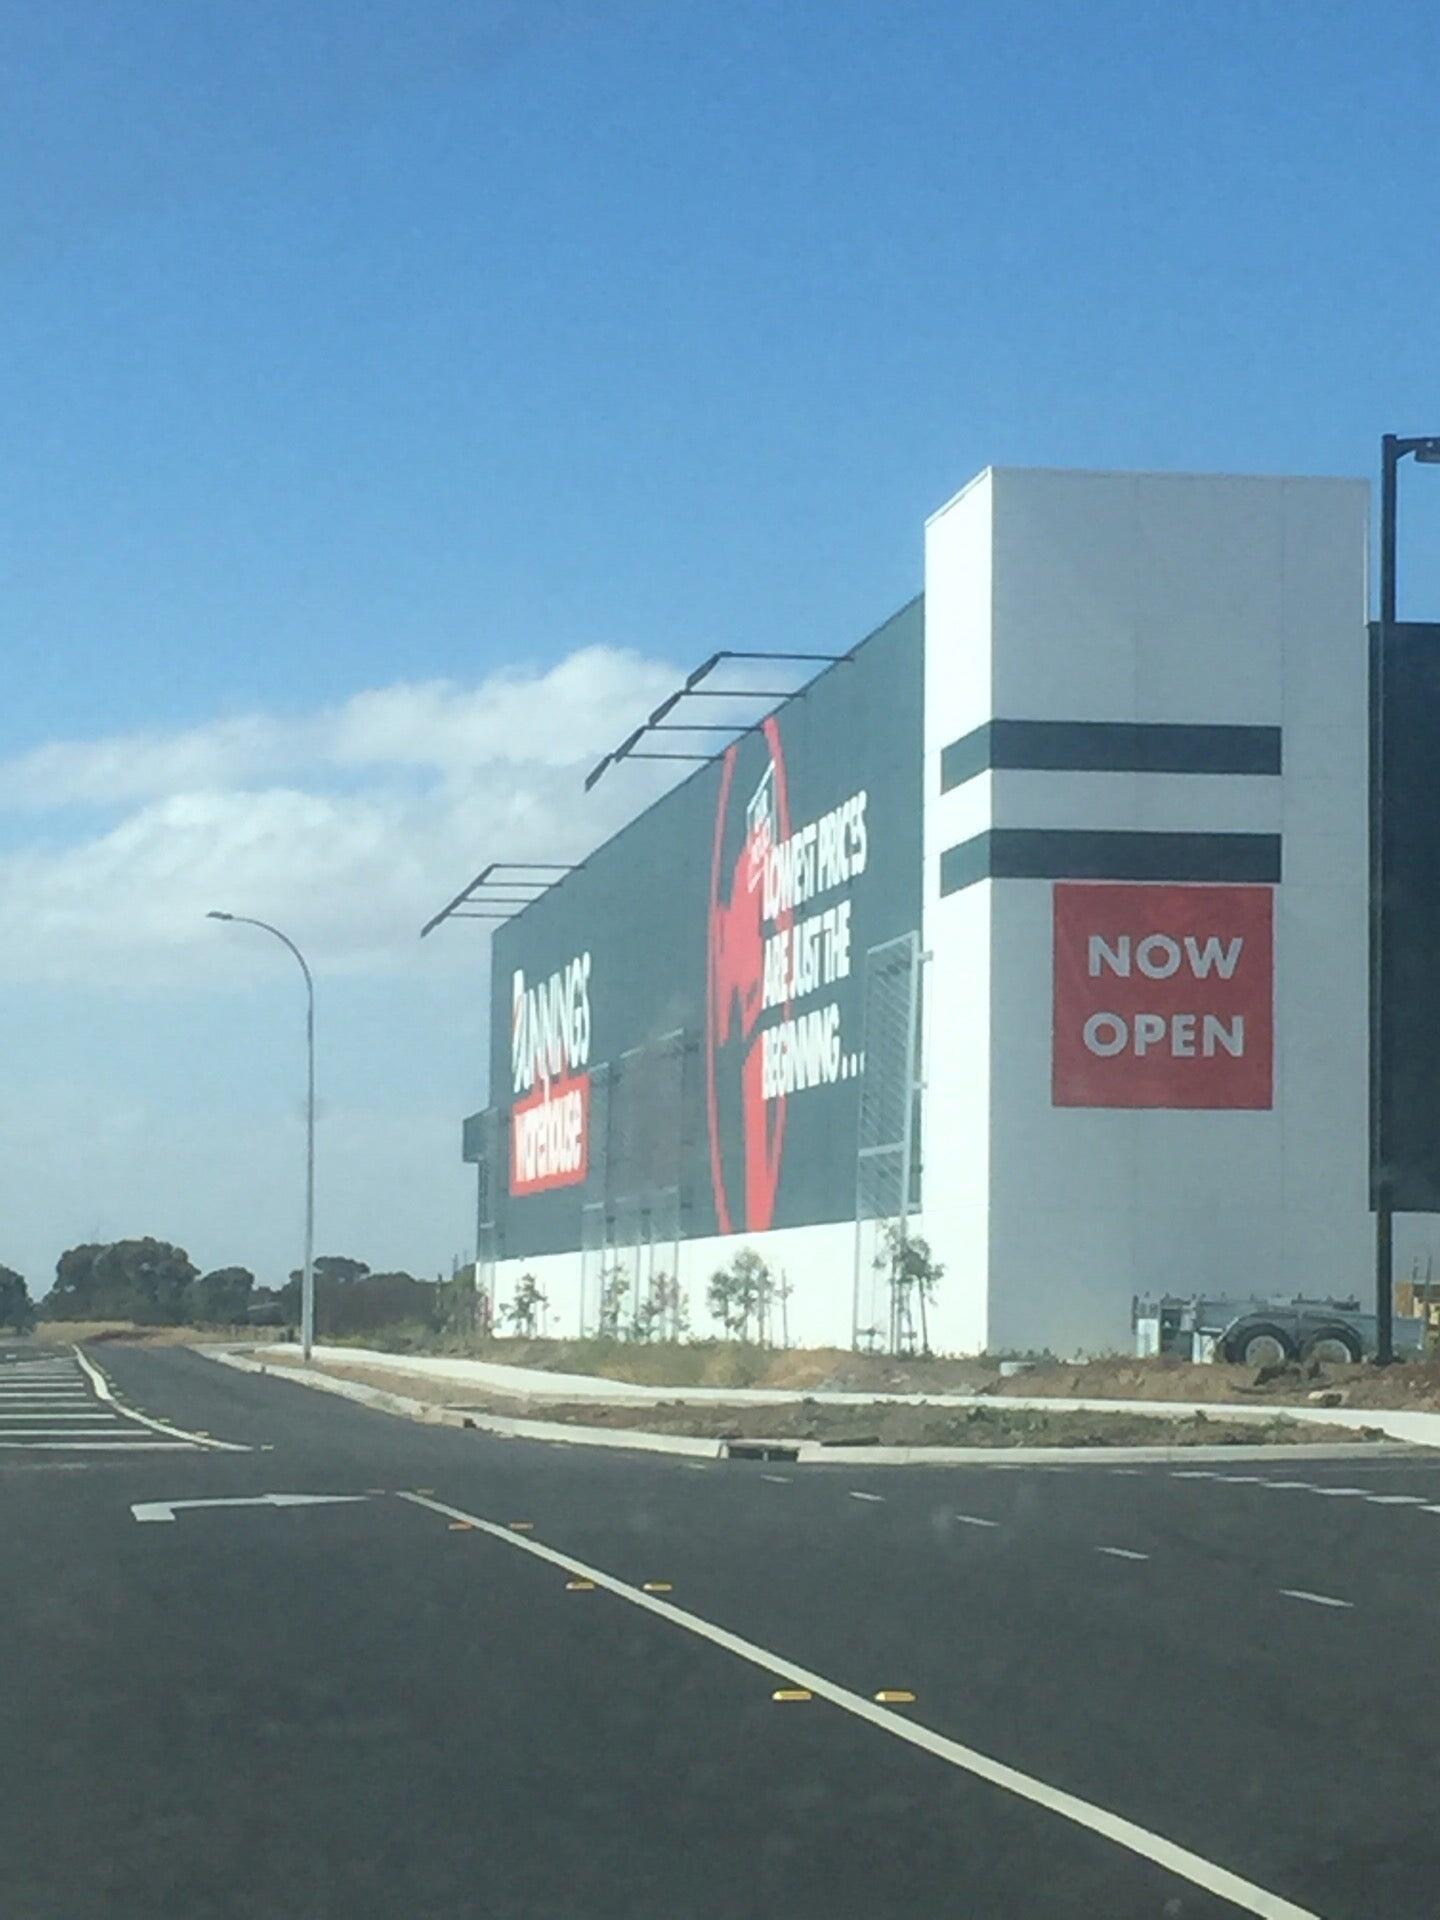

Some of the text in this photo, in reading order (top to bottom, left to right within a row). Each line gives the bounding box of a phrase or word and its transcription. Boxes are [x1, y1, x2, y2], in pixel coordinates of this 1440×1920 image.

[763, 790, 867, 921] LOWEST PRICES
[762, 899, 851, 1010] ARE JUST THE
[1088, 934, 1244, 979] NOW
[512, 951, 591, 1093] BUNNINGS
[1082, 1012, 1244, 1057] OPEN
